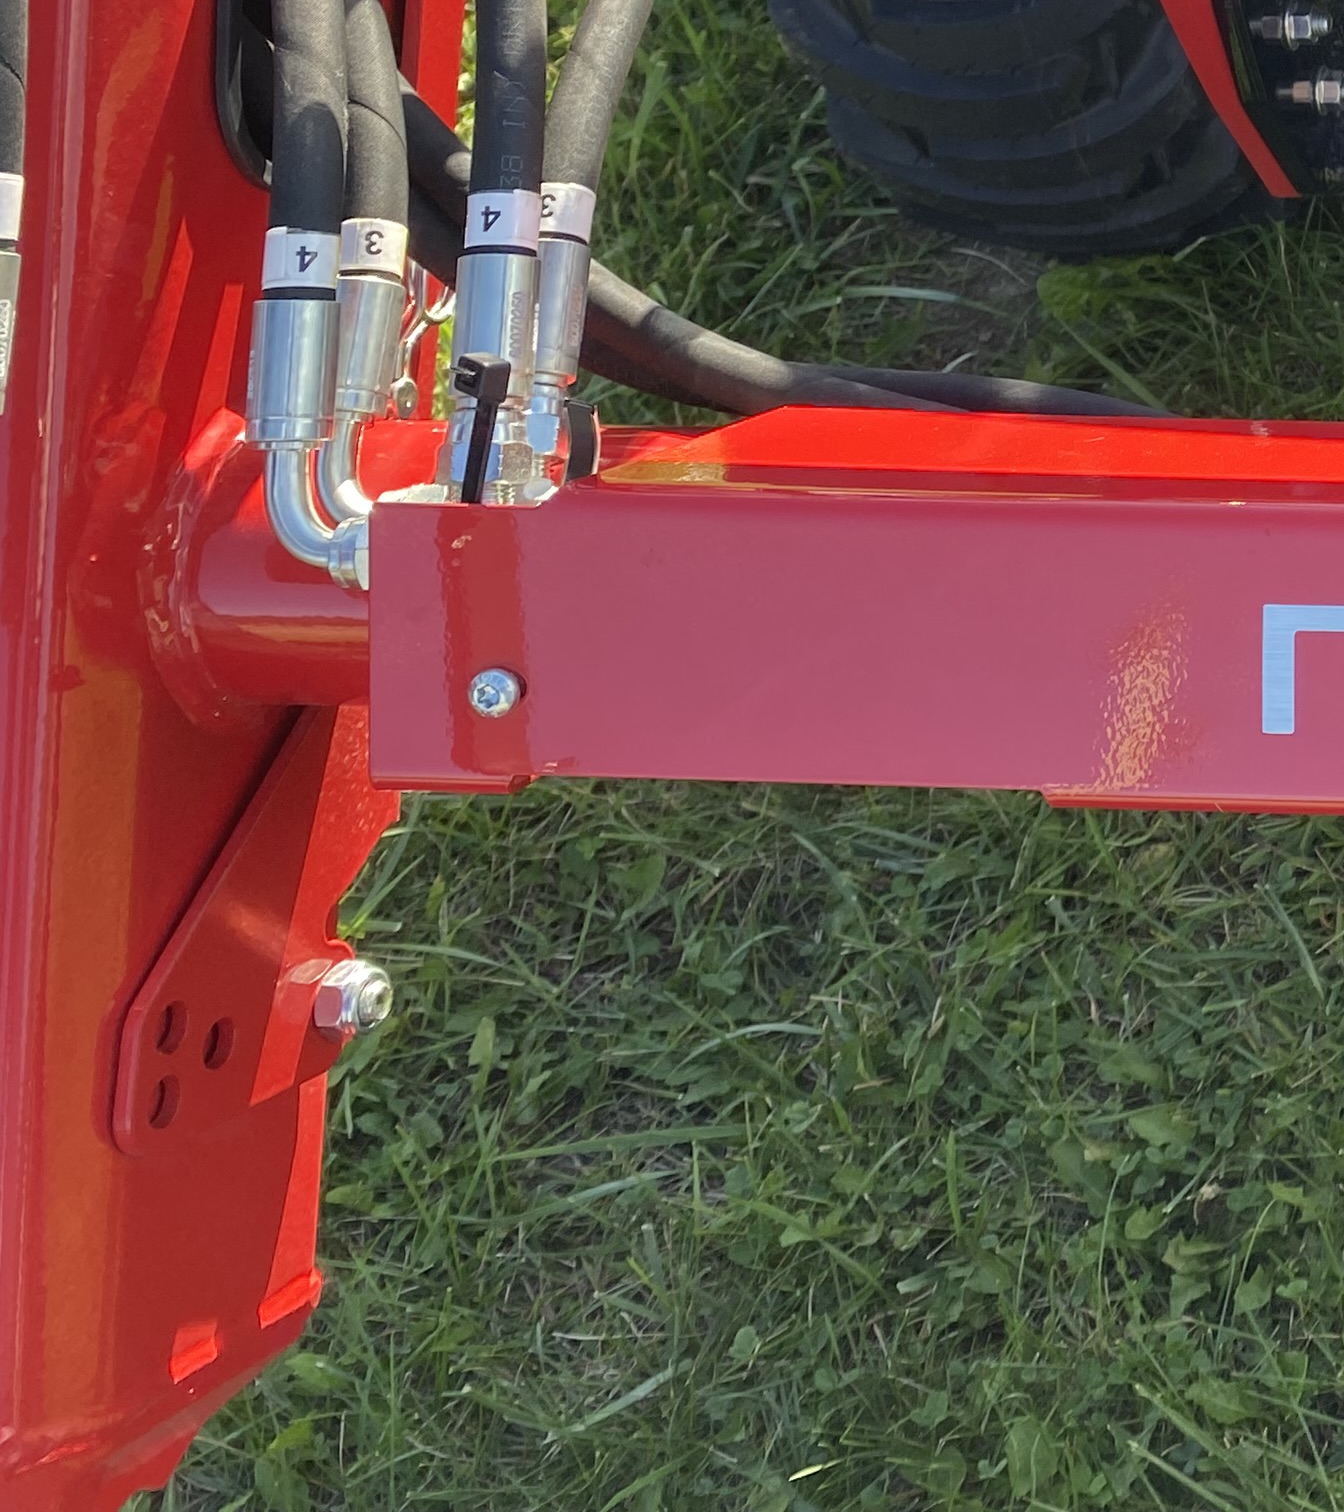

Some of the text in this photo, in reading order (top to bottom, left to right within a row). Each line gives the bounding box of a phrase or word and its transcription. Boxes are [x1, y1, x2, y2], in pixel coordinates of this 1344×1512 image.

[480, 205, 501, 232] 4
[541, 194, 557, 218] 3
[364, 230, 385, 255] 3
[295, 245, 318, 272] 4
